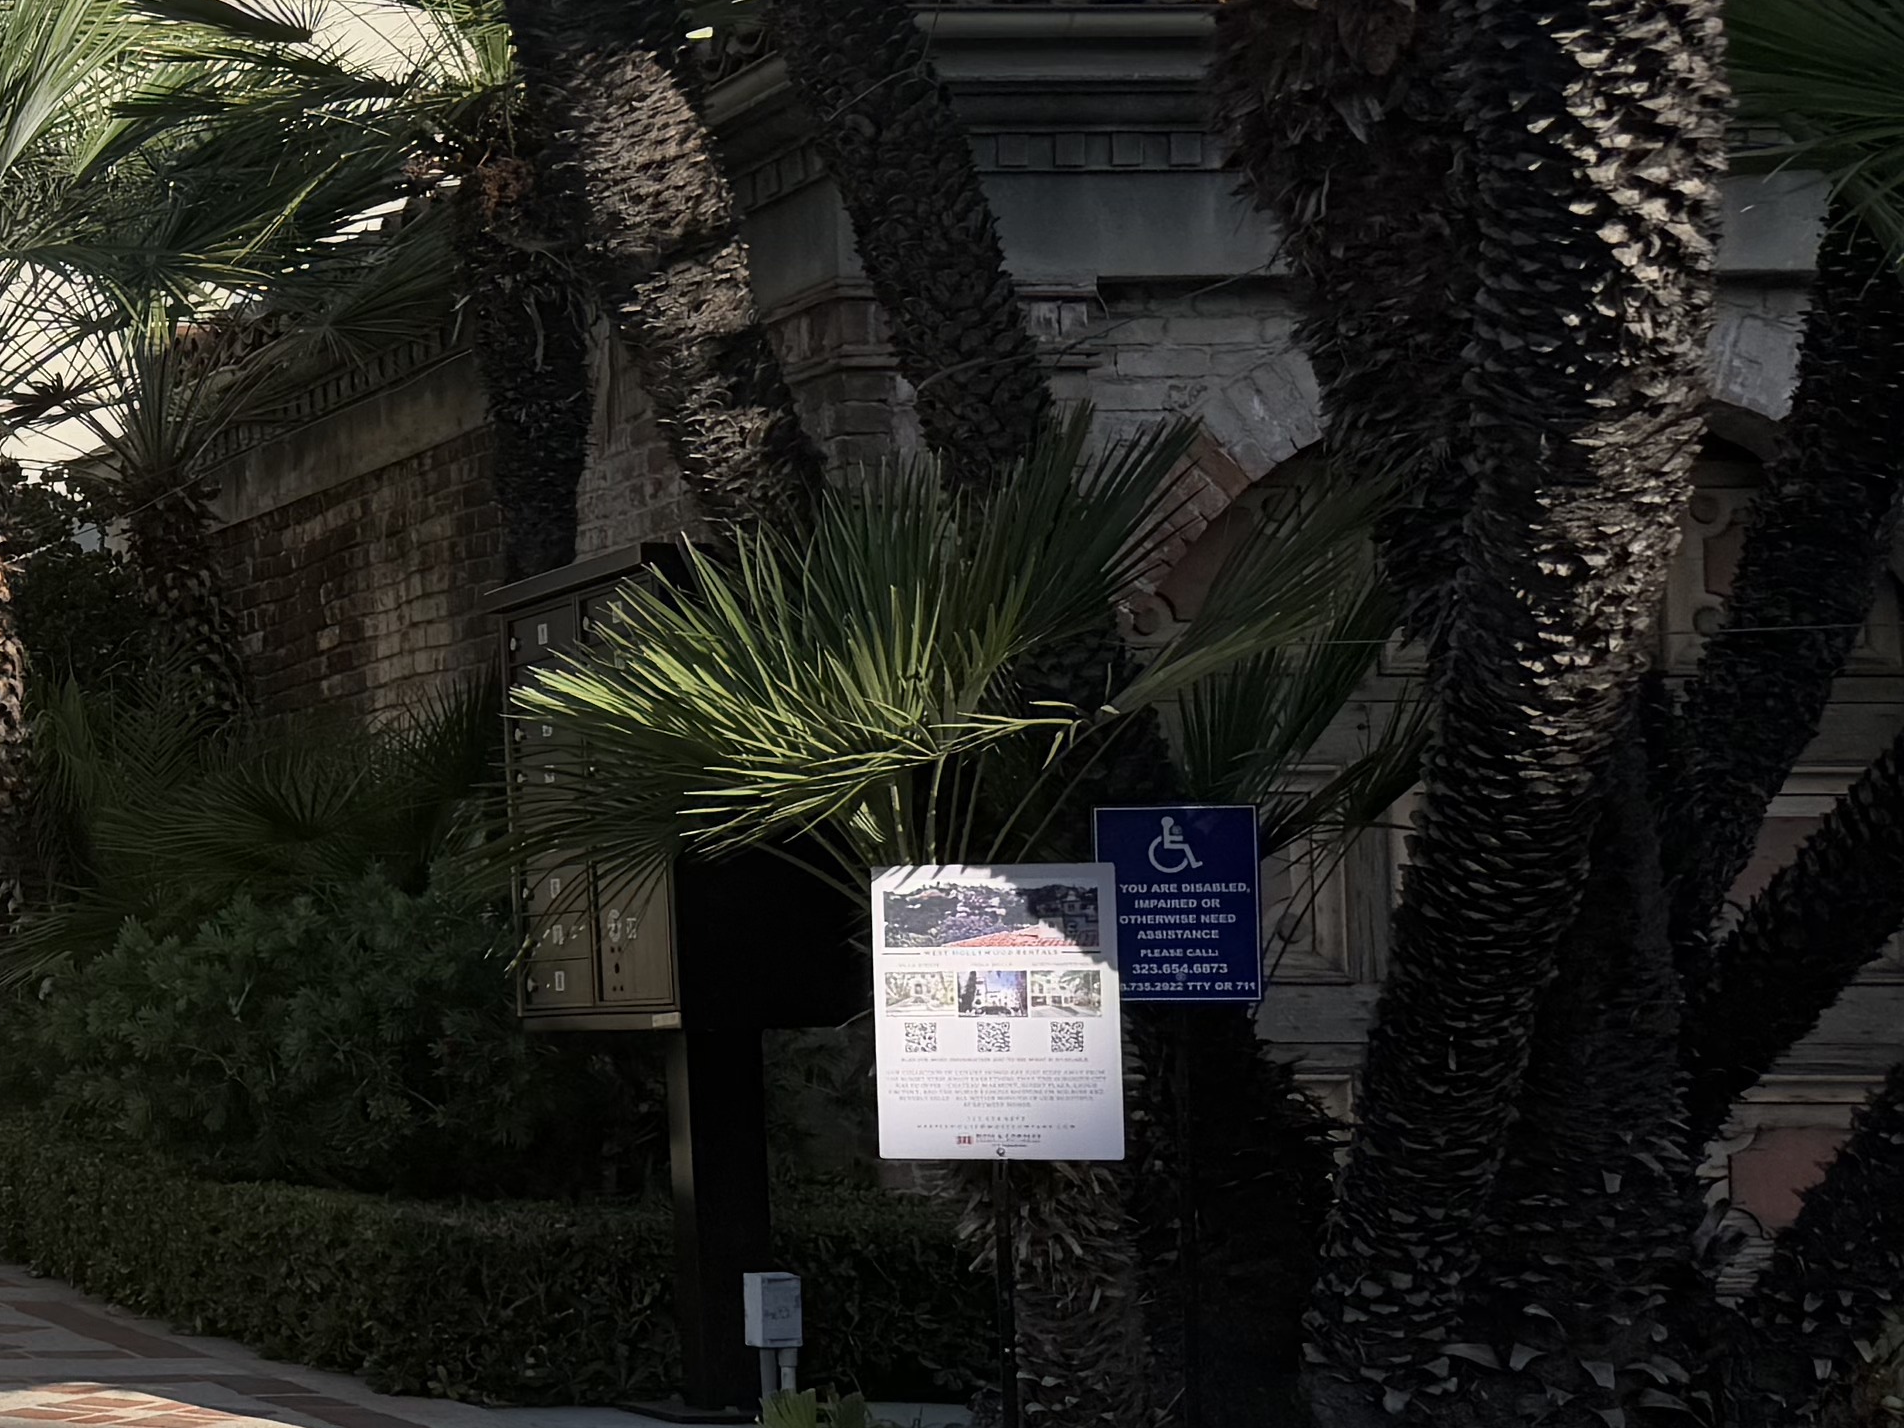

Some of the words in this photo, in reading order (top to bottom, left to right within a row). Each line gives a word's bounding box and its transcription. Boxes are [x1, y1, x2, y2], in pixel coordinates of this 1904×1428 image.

[1119, 883, 1148, 893] YOU
[1151, 883, 1178, 893] ARE
[1181, 882, 1251, 893] DISABLED,
[1134, 899, 1197, 909] IMPAIRED
[1201, 898, 1221, 908] OR
[1119, 914, 1197, 924] OTHERWISE
[1200, 914, 1237, 923] NEED
[1137, 929, 1220, 940] ASSISTANCE
[1140, 948, 1184, 958] PLEASE
[1186, 981, 1212, 991] TTY
[1214, 981, 1233, 991] OR
[1236, 981, 1256, 991] 711
